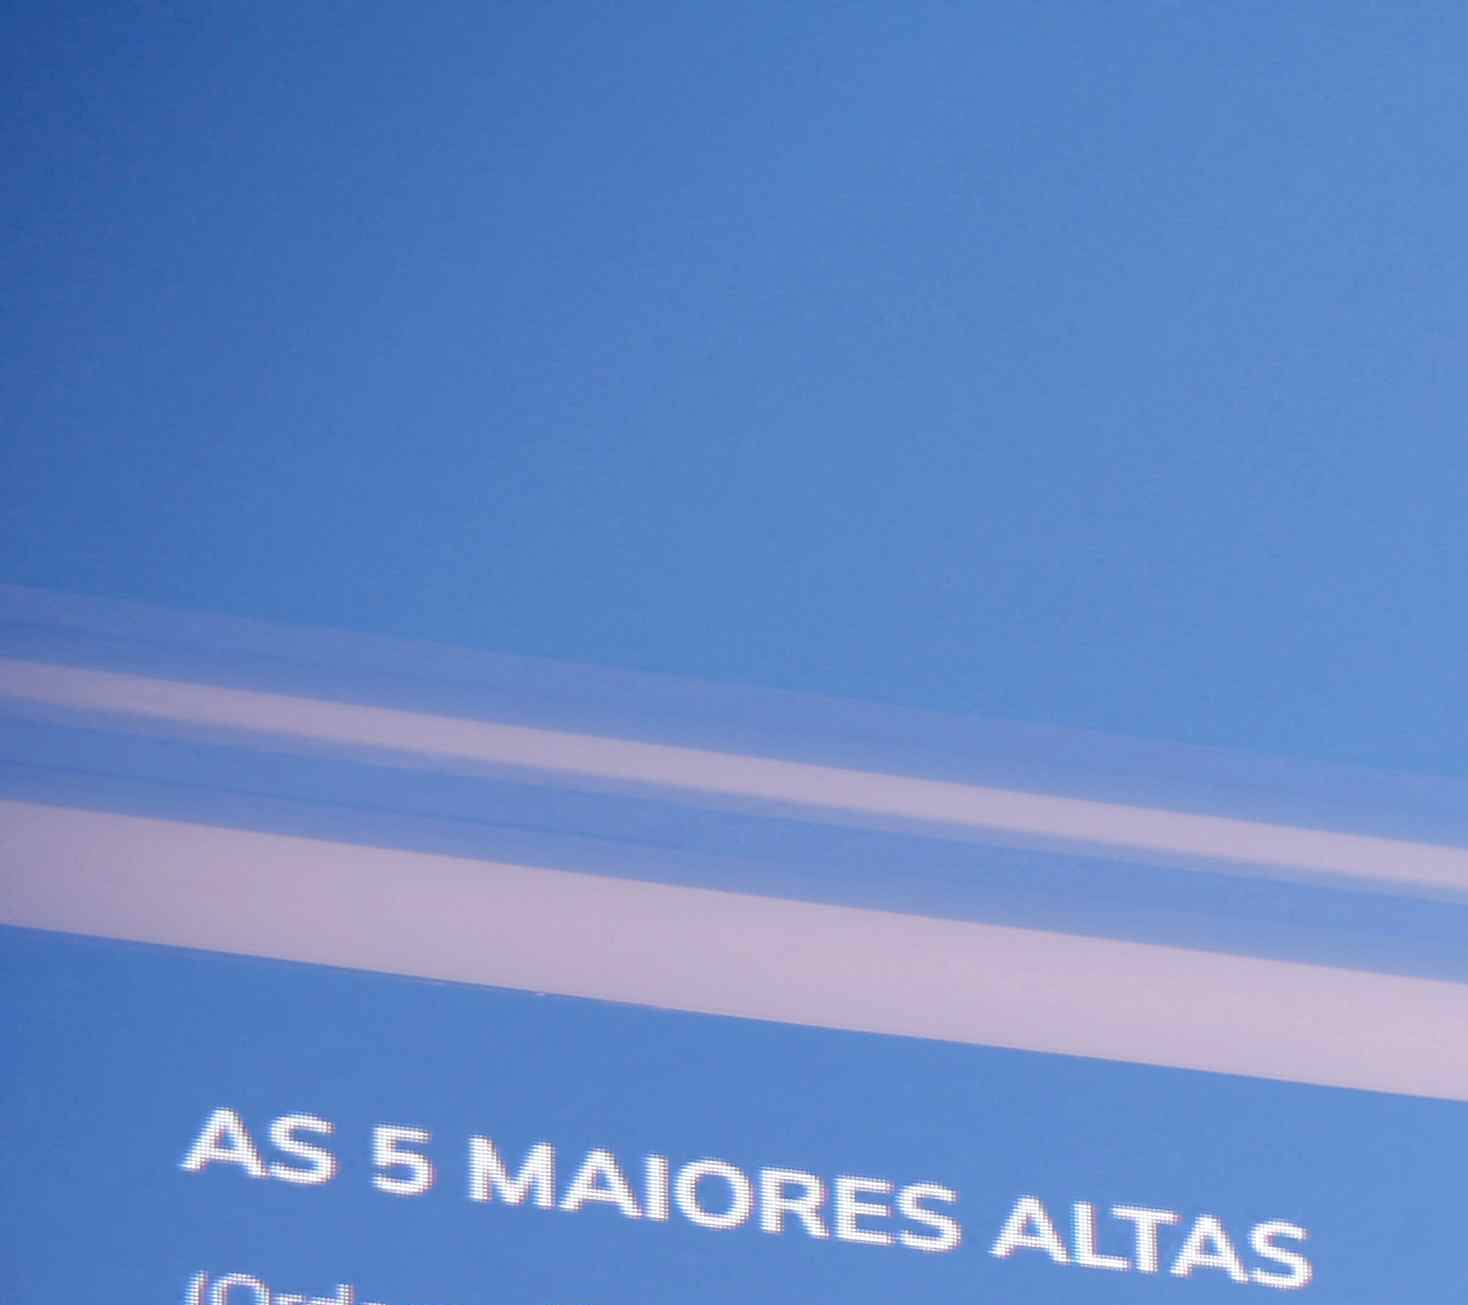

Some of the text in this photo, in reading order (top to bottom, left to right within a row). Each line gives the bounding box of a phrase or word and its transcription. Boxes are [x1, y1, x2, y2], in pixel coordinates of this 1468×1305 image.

[181, 1106, 1313, 1291] AS 5 MAIORES ALTAS
